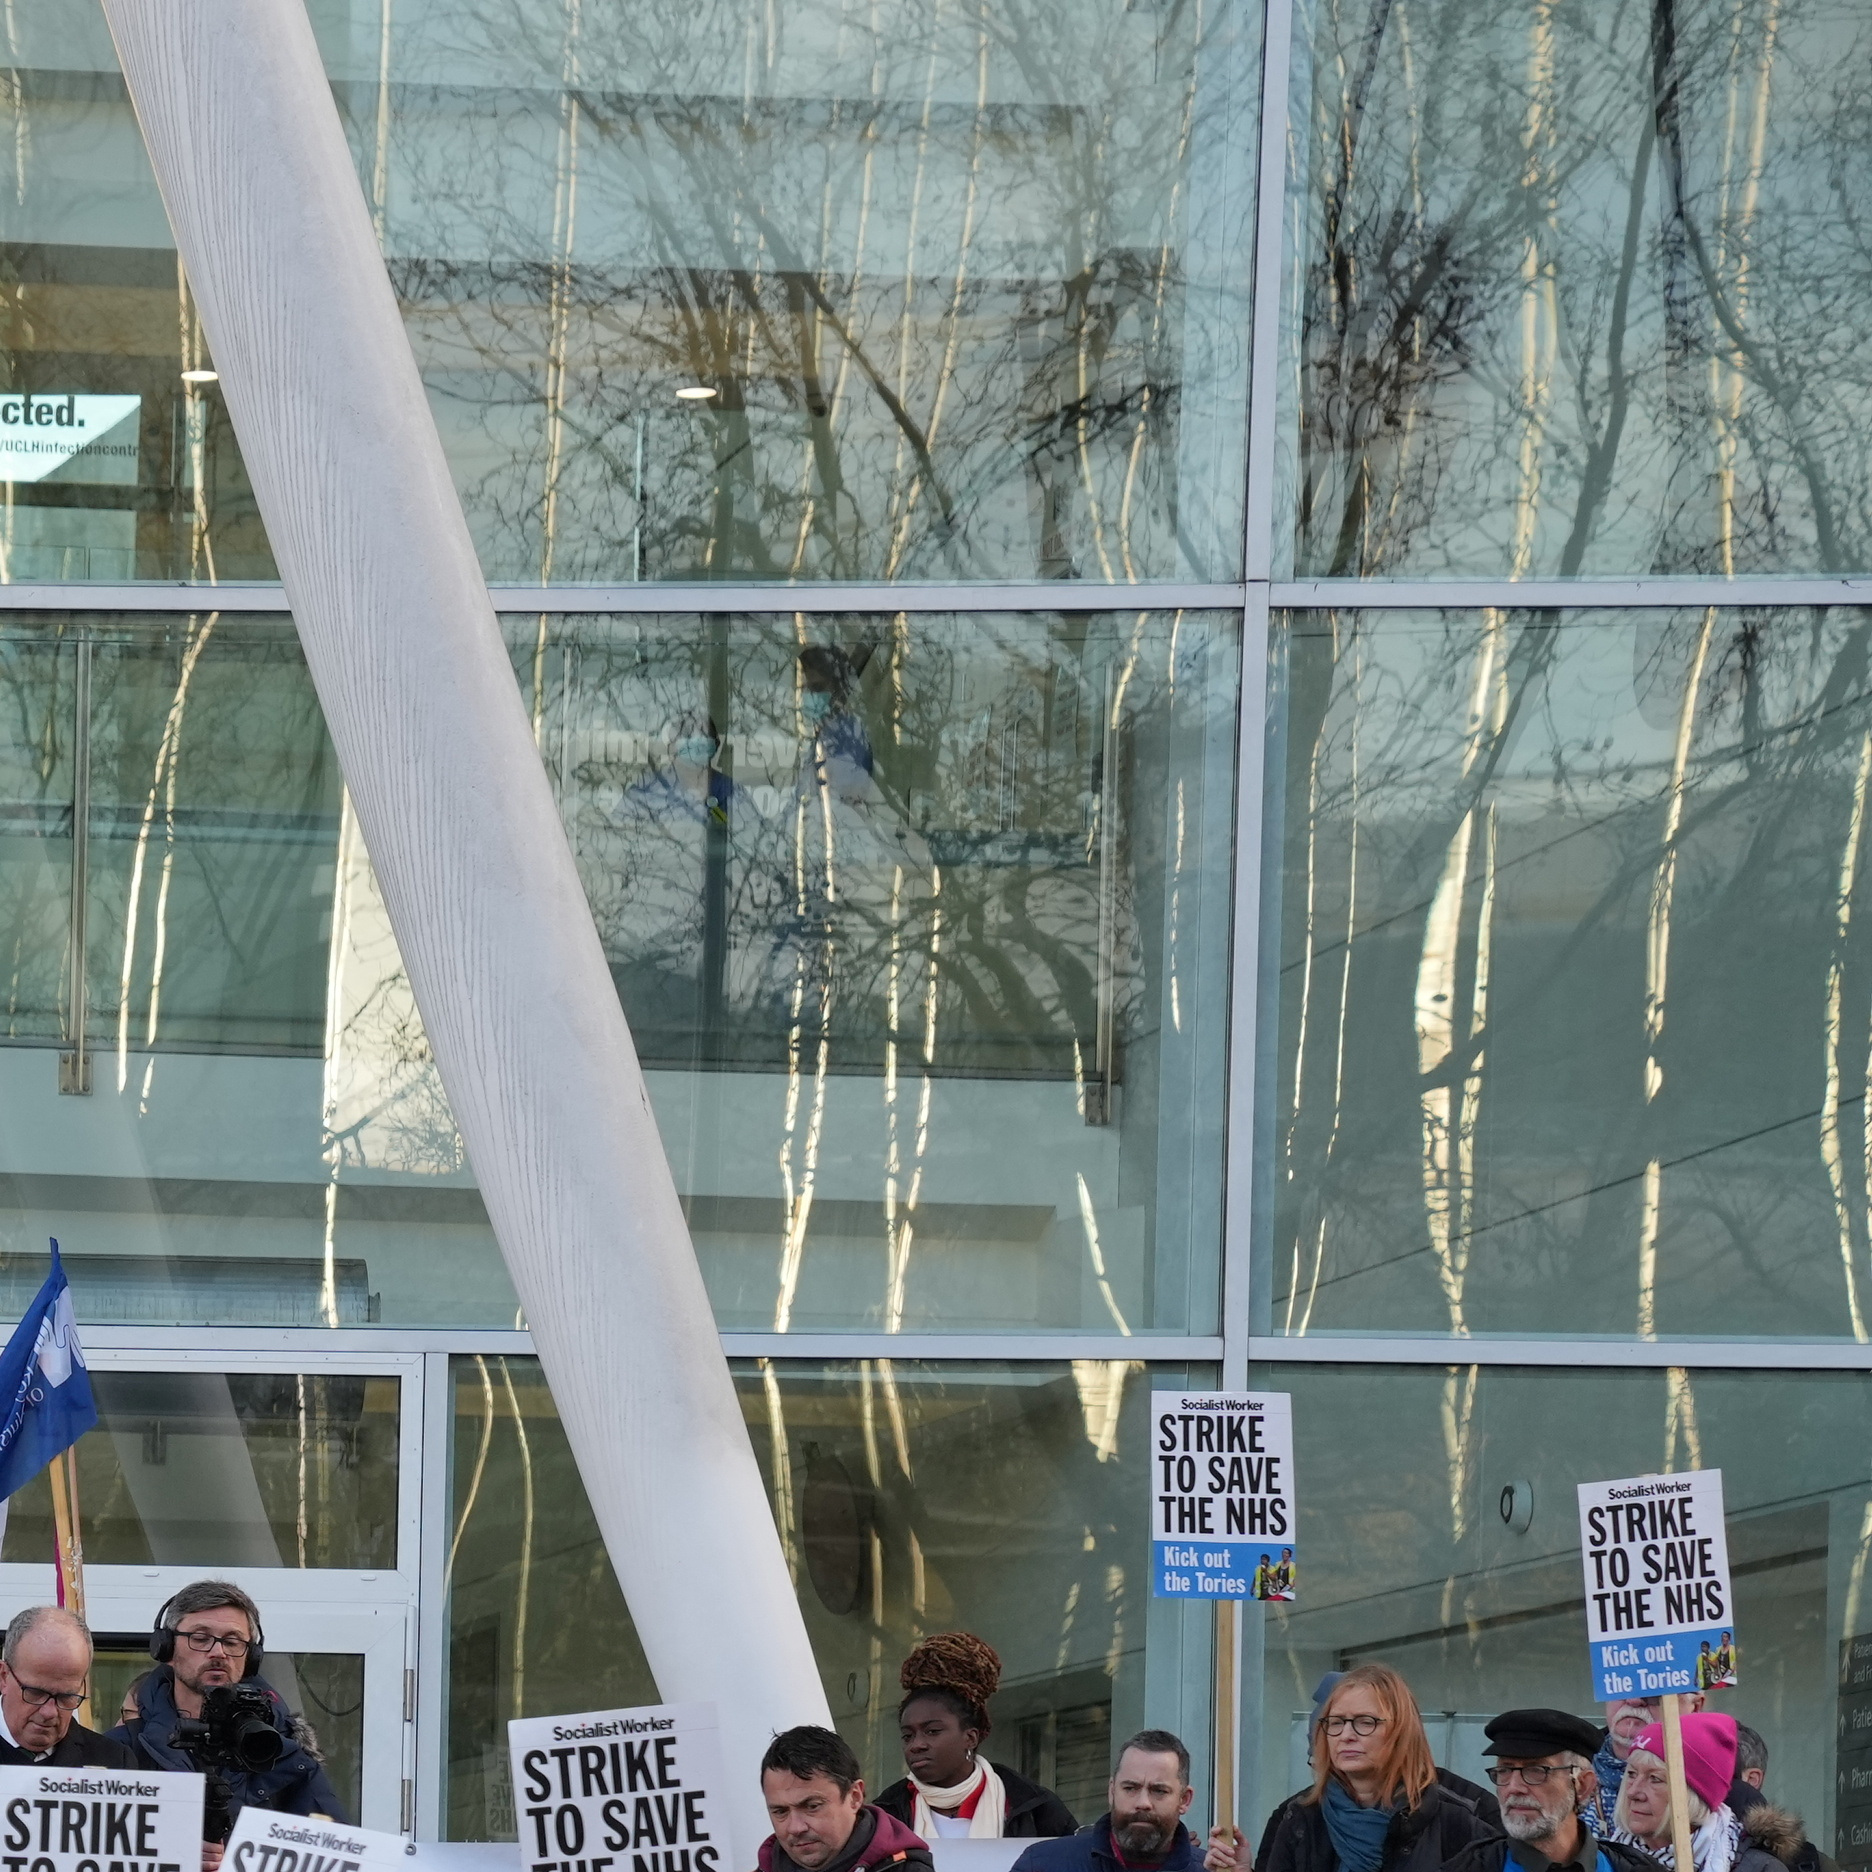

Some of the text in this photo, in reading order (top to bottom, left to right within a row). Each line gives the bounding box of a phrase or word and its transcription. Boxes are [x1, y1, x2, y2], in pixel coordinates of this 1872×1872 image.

[1159, 1414, 1265, 1453] STRIKE
[1159, 1455, 1281, 1494] TO SAVE
[1159, 1496, 1287, 1536] THE NHS
[1587, 1497, 1696, 1547] STRIKE
[1164, 1546, 1230, 1568] Kick out
[1589, 1538, 1715, 1589] TO SAVE
[1164, 1571, 1246, 1594] the Tories
[1593, 1580, 1724, 1633] THE NHS
[523, 1736, 681, 1802] STRIKE
[4, 1798, 159, 1857] STRIKE
[526, 1790, 709, 1858] TO SAVE
